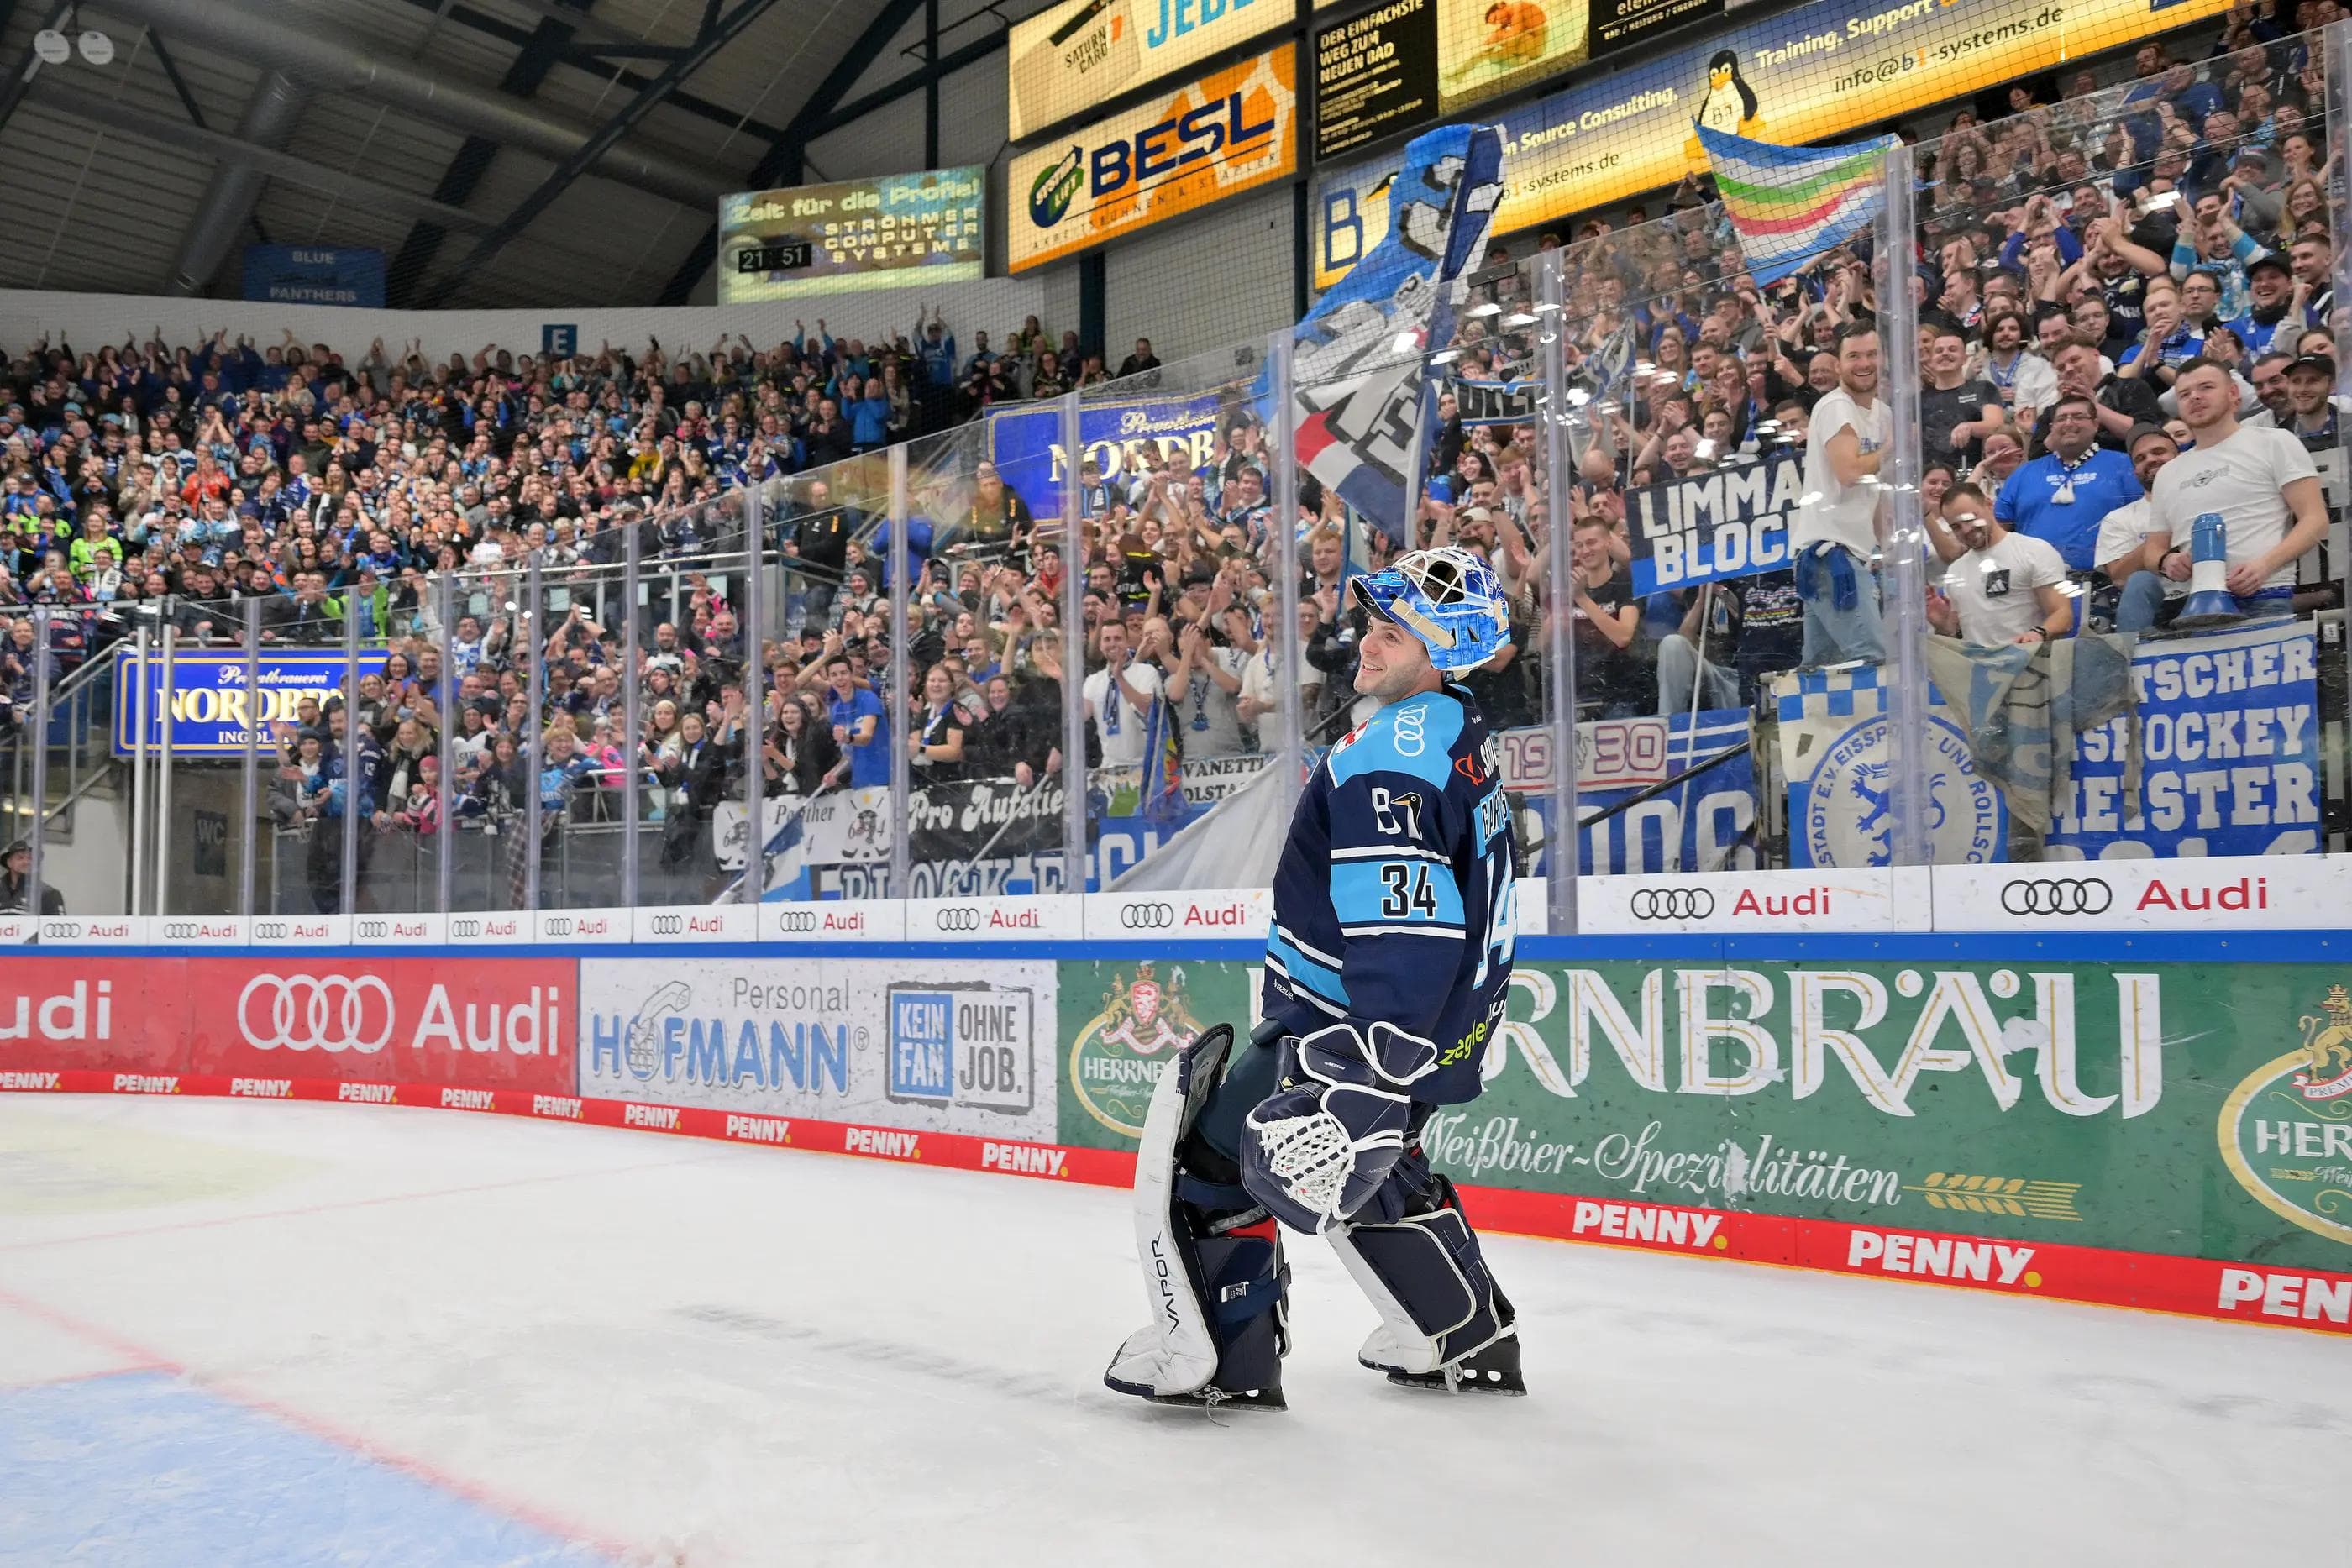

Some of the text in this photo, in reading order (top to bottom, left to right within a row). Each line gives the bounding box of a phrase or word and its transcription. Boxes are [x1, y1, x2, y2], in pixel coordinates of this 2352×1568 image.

[1320, 0, 1424, 50] DER EINFACHSTE
[1065, 27, 1106, 68] SATURN
[1080, 43, 1109, 74] CARD
[1320, 29, 1380, 66] WEG ZUM
[1320, 53, 1364, 83] NEUEN
[1366, 41, 1394, 65] BAD
[1835, 7, 2066, 93] info@b1-systems.de
[1520, 120, 1576, 150] Source
[1846, 2, 1935, 37] Support
[1091, 92, 1275, 198] BESL
[729, 201, 785, 224] Zeit
[792, 197, 833, 218] für
[840, 191, 881, 212] die
[824, 222, 978, 250] COMPUTER
[291, 249, 336, 265] BLUE
[269, 286, 358, 302] PANTHERS
[550, 328, 569, 354] E
[1594, 722, 1666, 774] 30
[1938, 737, 1975, 776] UND
[960, 780, 1065, 833] Aufstie
[197, 818, 226, 847] WC
[1379, 863, 1437, 920] 34
[1733, 886, 1831, 916] Audi
[2136, 877, 2268, 911] Audi
[88, 924, 129, 938] Audi
[200, 924, 238, 938] Audi
[293, 924, 329, 938] Audi
[393, 922, 428, 937] Audi
[486, 920, 517, 936] Audi
[577, 918, 608, 935] Audi
[689, 915, 724, 933] Audi
[823, 912, 865, 931] Audi
[989, 907, 1039, 929] Audi
[1184, 903, 1247, 926] Audi
[733, 977, 851, 1011] Personal
[412, 983, 560, 1056] Audi
[897, 1002, 1018, 1045] KEIN OHNE
[897, 1042, 1024, 1094] FAN JOB.
[1150, 1230, 1180, 1335] VAPOR
